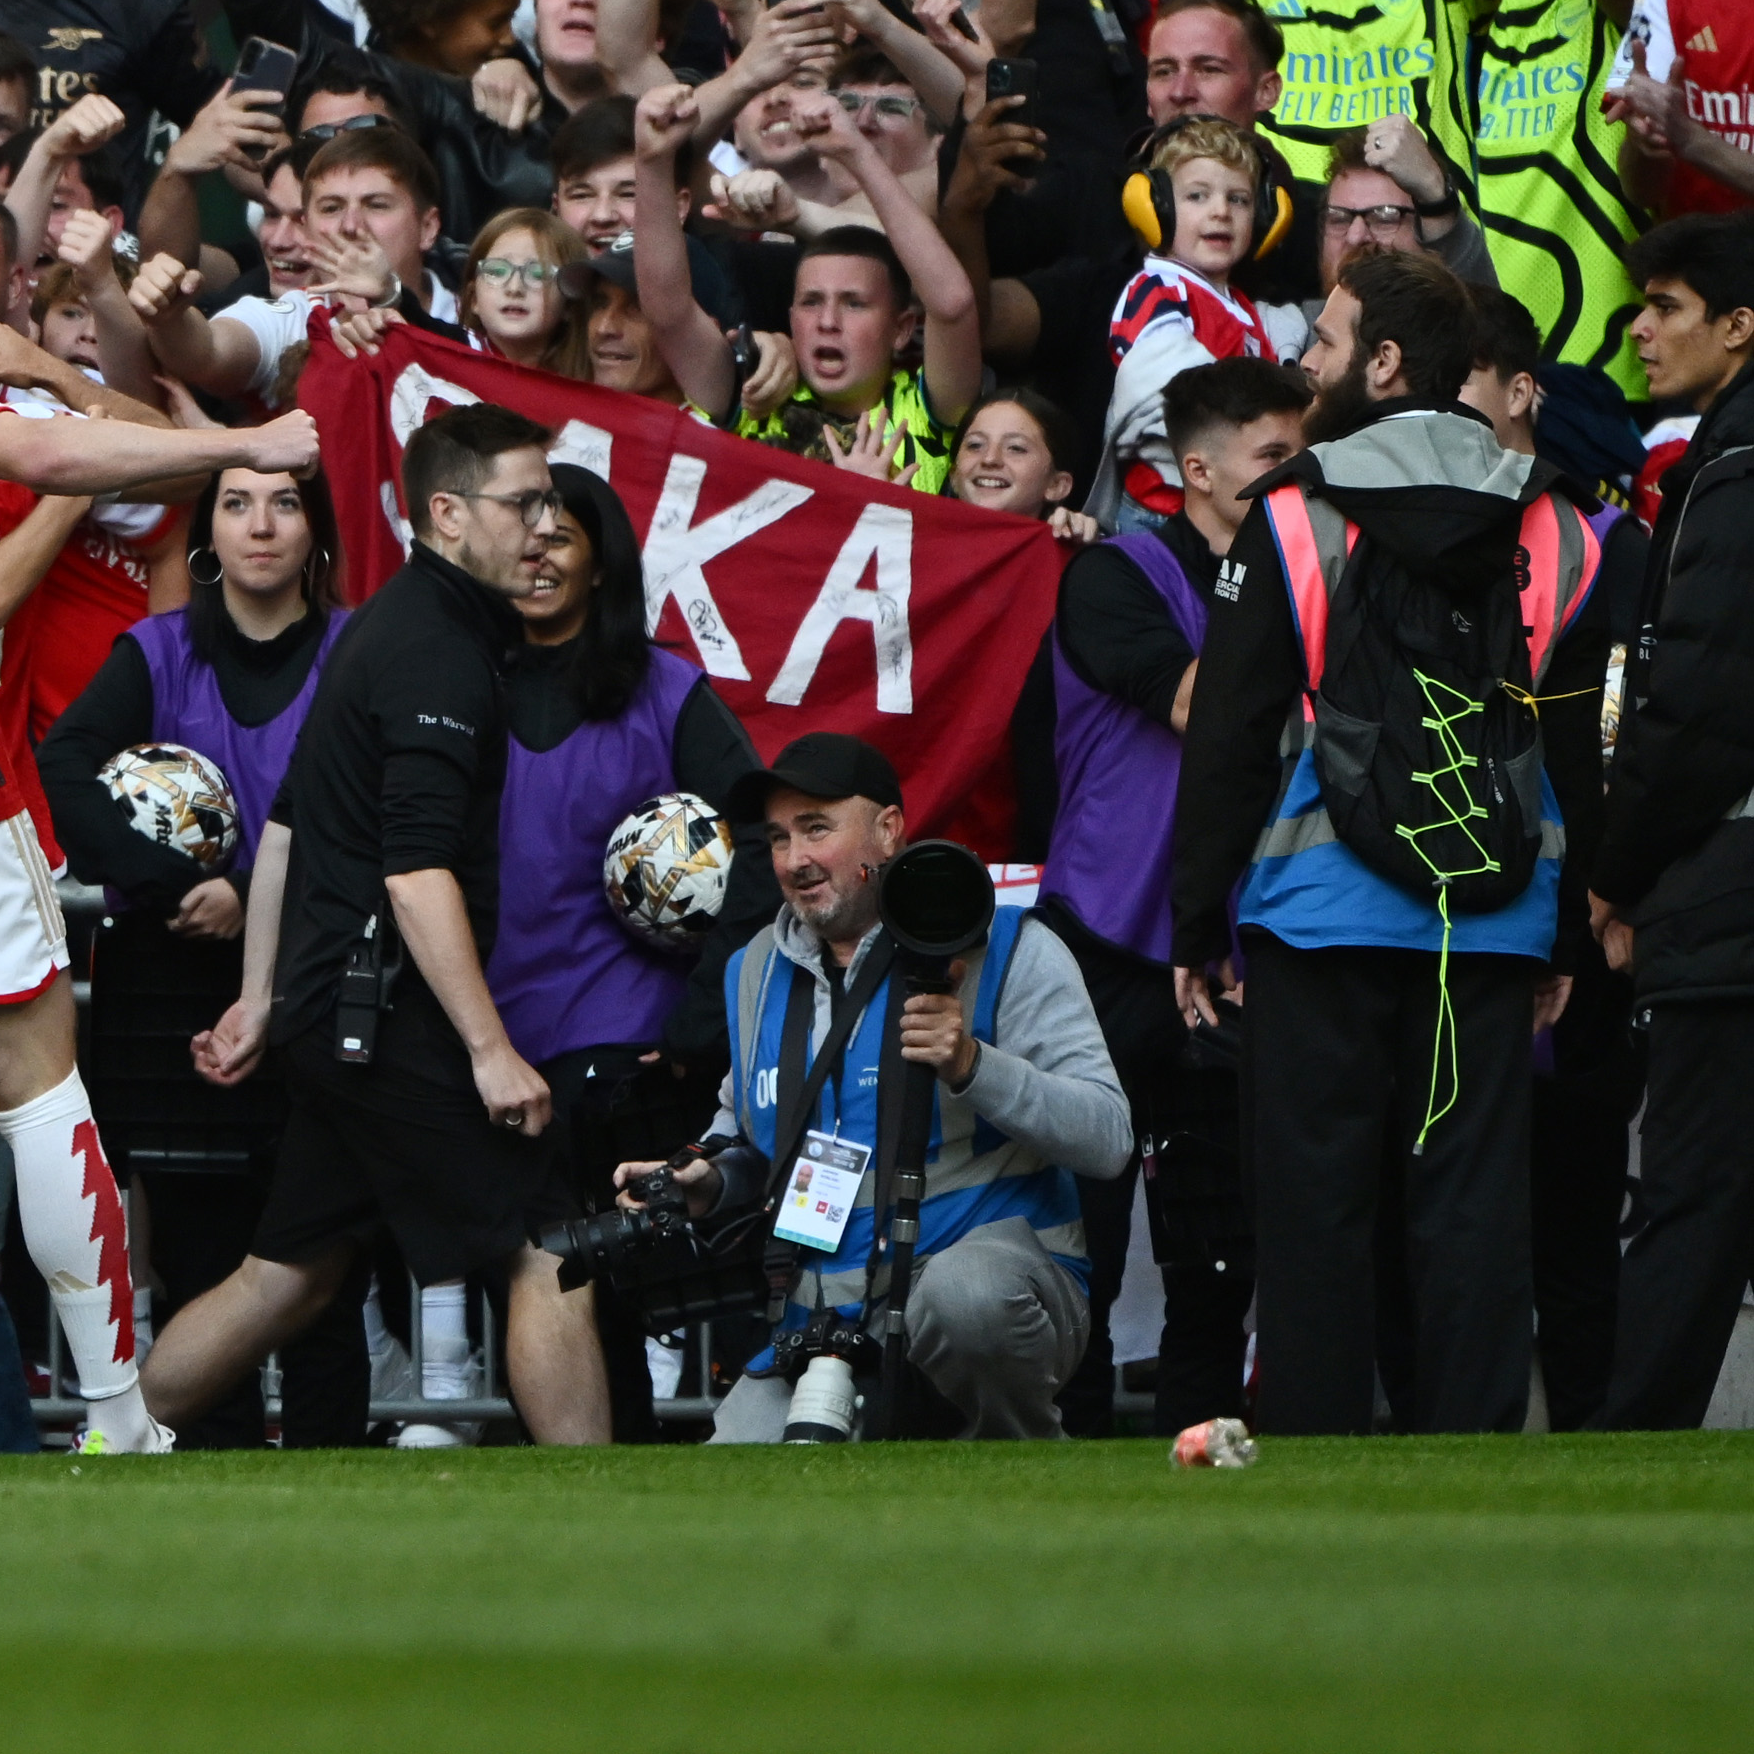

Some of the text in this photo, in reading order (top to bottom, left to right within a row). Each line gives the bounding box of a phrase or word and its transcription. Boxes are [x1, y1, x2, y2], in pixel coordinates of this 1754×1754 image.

[1287, 43, 1435, 86] mirates
[1279, 87, 1411, 122] FLY BETTER
[417, 715, 437, 724] The
